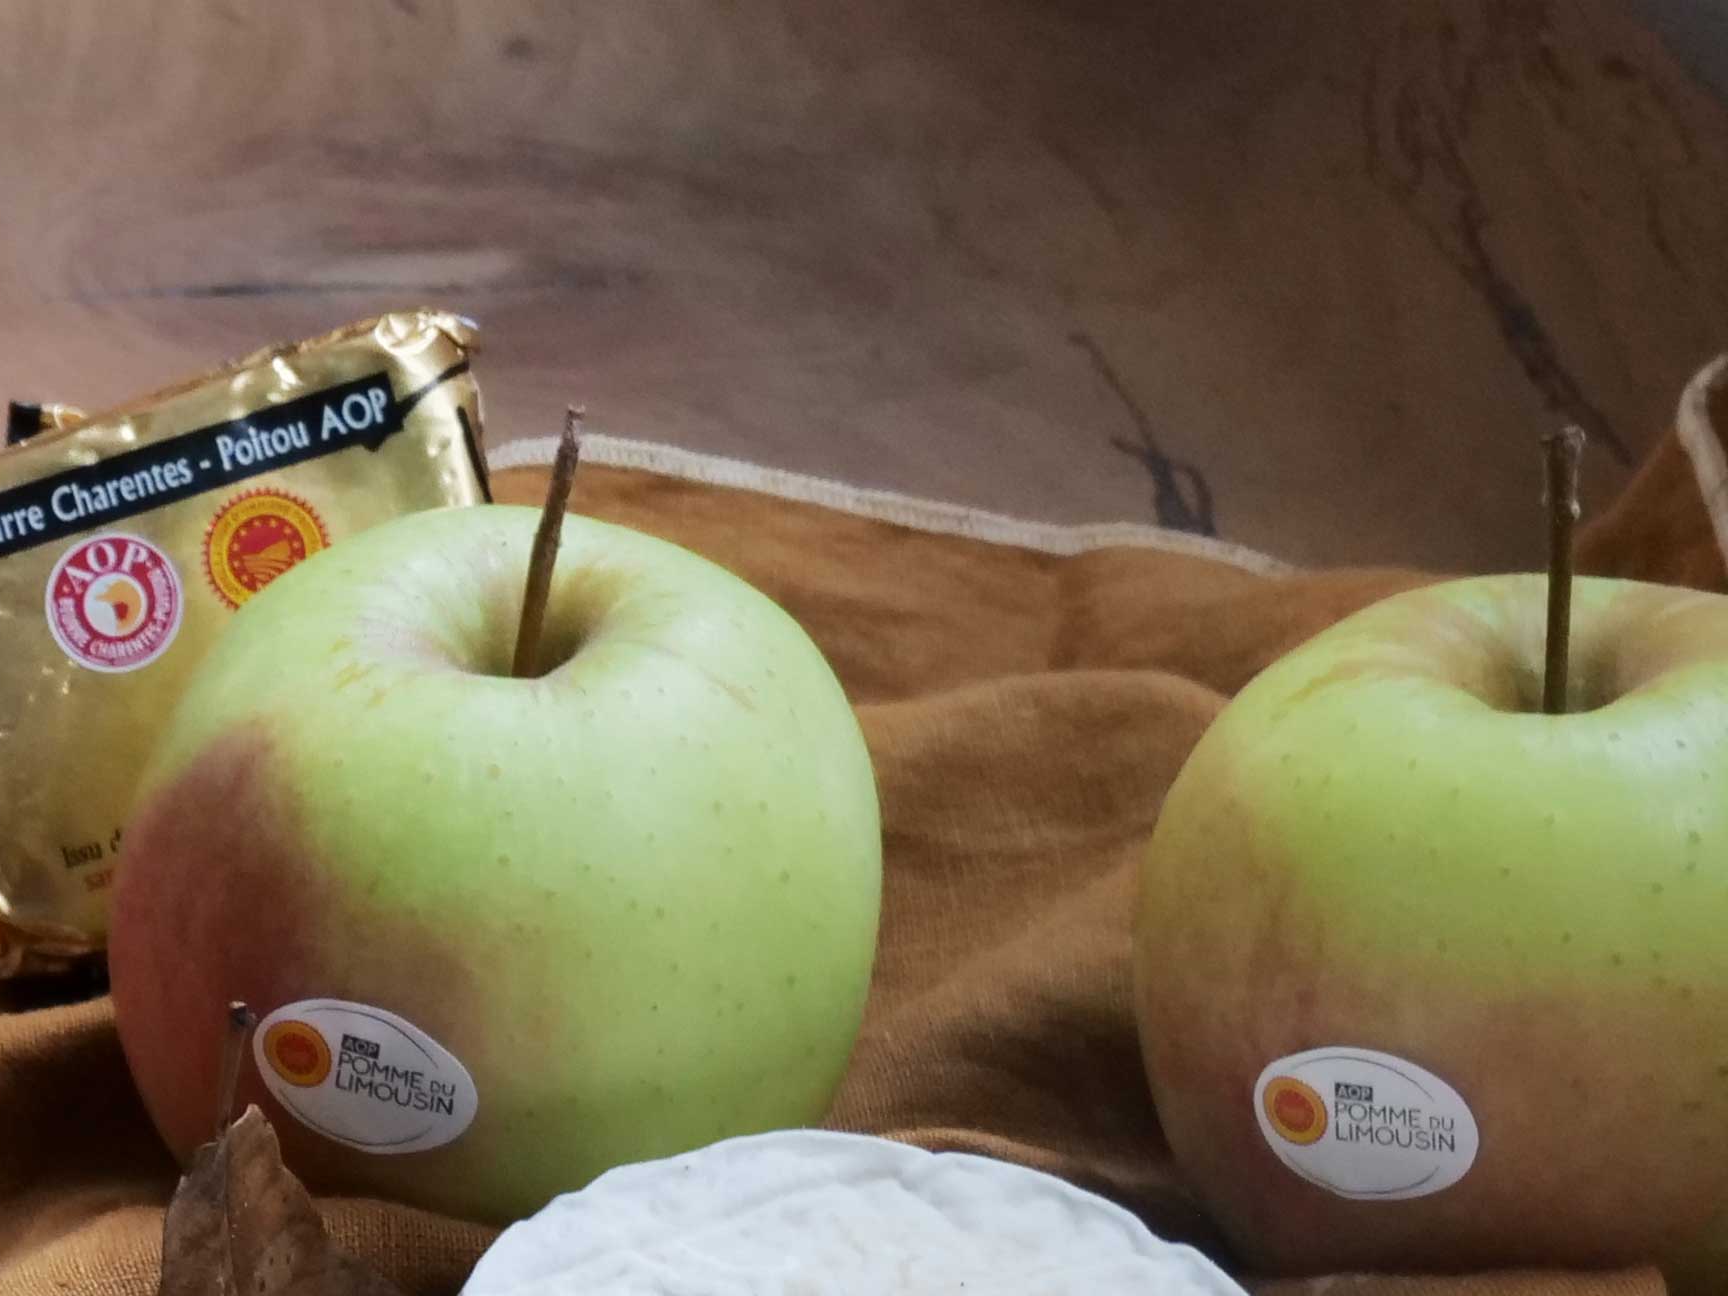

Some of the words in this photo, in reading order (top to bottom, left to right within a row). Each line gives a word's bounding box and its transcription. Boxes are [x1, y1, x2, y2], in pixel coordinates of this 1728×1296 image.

[51, 455, 195, 522] Charentes
[216, 418, 311, 472] Poitou
[319, 388, 389, 441] AOP
[63, 541, 148, 595] AOP
[334, 1069, 455, 1116] LIMOUSIN
[337, 1051, 425, 1091] POMME
[429, 1079, 457, 1097] DU
[1337, 1084, 1373, 1101] AOP
[1334, 1101, 1422, 1129] POMME
[1428, 1116, 1456, 1132] DU
[1334, 1123, 1457, 1152] LIMOUSIN
